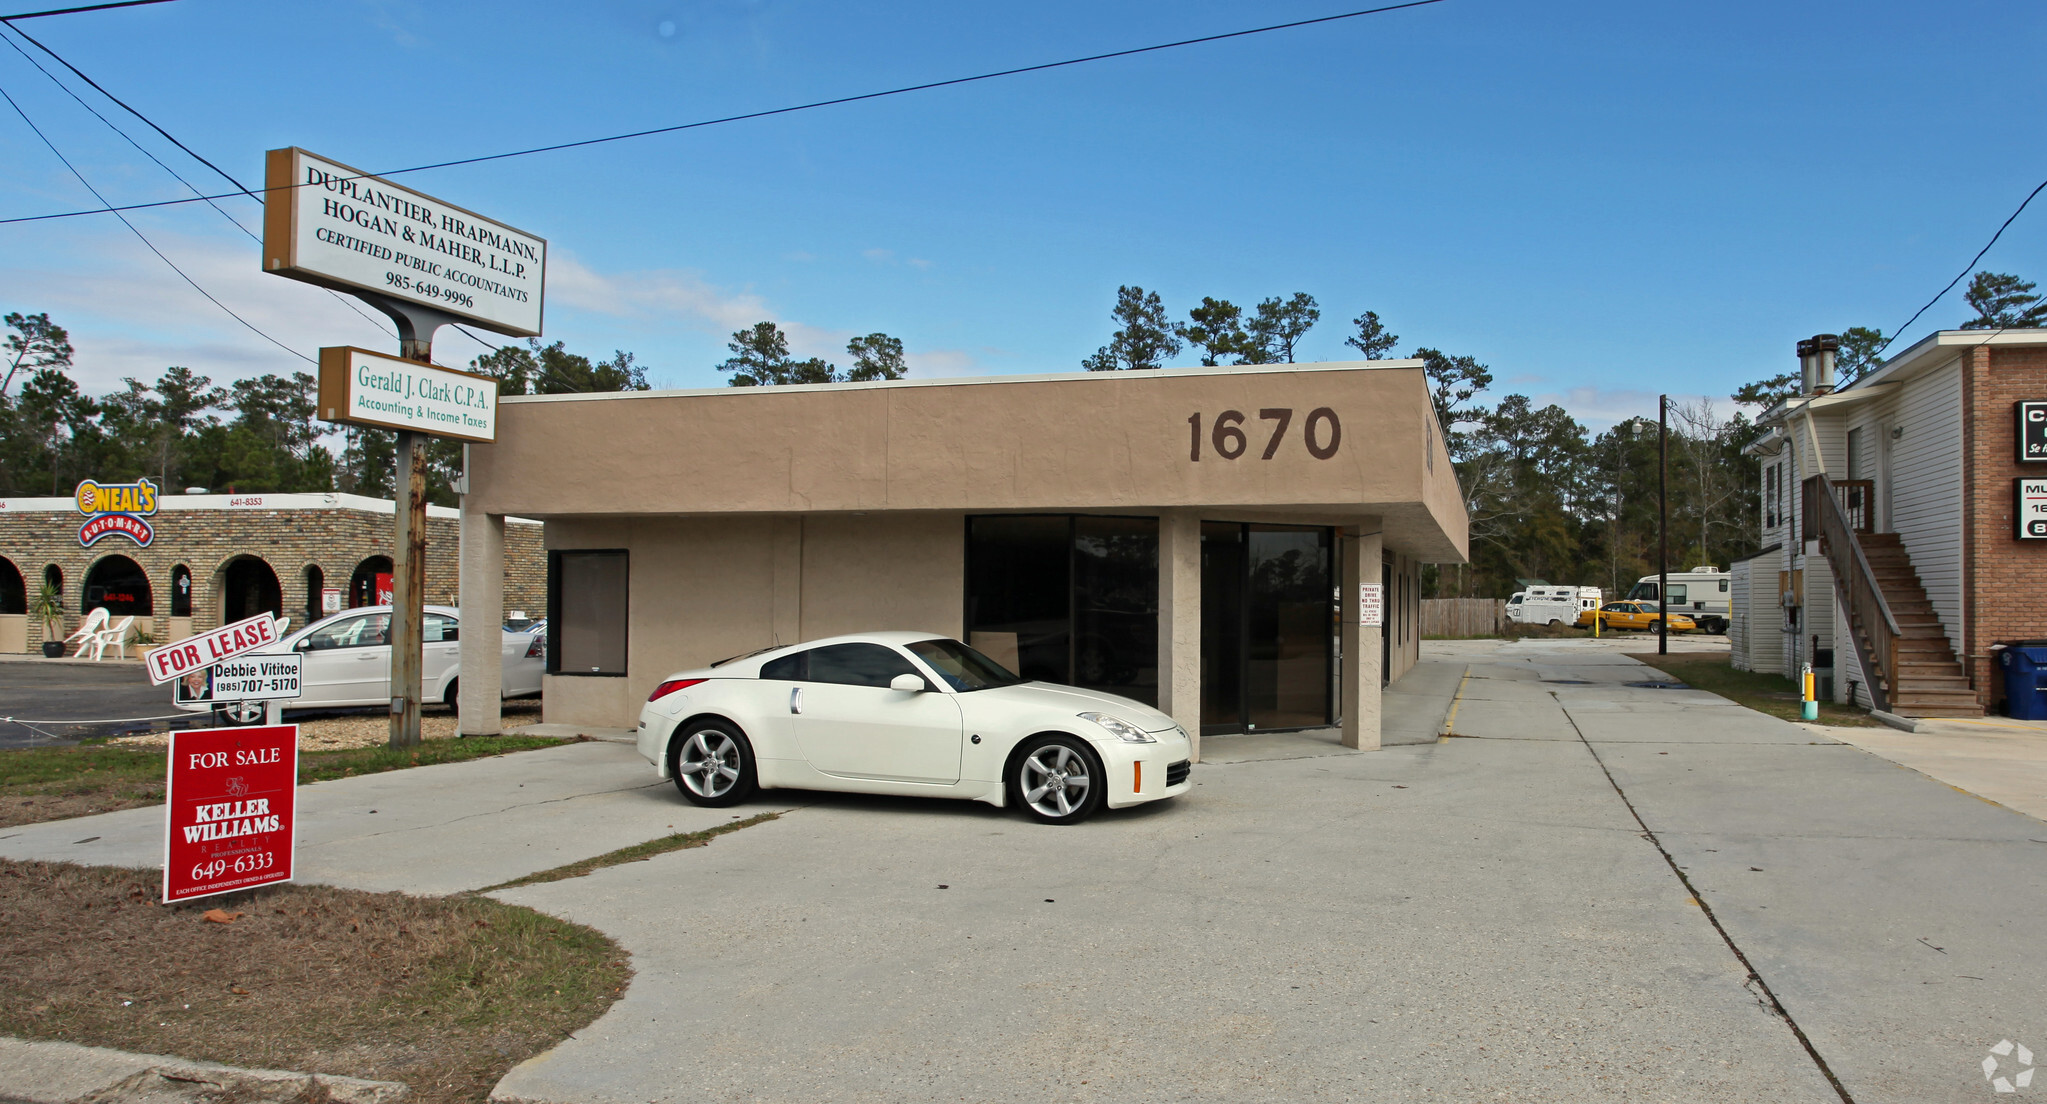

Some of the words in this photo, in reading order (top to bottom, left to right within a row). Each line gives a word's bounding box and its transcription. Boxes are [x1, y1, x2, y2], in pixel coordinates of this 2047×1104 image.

[307, 166, 438, 229] DUPLANTIER,
[441, 214, 538, 264] HRAPMANN,
[323, 197, 398, 238] HOGAN
[402, 225, 416, 244] &
[419, 230, 486, 268] MAHER,
[489, 253, 526, 280] L.L.P.
[316, 227, 392, 260] CERTIFIED
[395, 251, 441, 276] PUBLIC
[443, 268, 529, 303] ACCOUNTANTS
[386, 271, 474, 308] 985-649-9996
[358, 365, 402, 393] Gerald
[405, 375, 415, 400] J.
[419, 377, 451, 403] Clark
[454, 385, 489, 410] C.P.A.
[358, 395, 413, 419] Accounting
[416, 405, 424, 418] &
[427, 407, 460, 424] Income
[463, 413, 488, 429] Taxes
[2028, 409, 2047, 422] C
[1188, 407, 1342, 462] 1670
[230, 497, 263, 507] 641-8353
[157, 644, 202, 676] FOR
[207, 620, 272, 659] LEASE
[215, 664, 257, 678] Debbie
[260, 662, 298, 676] Vititoe
[189, 752, 229, 770] FOR
[236, 747, 281, 766] SALE
[195, 798, 270, 823] KELLER
[191, 851, 274, 881] 649-6333
[211, 846, 262, 858] PROFESSIONALS
[176, 887, 190, 895] EACH
[190, 884, 207, 893] OFFICE
[207, 879, 242, 890] INDEPENDENTLY
[243, 876, 259, 884] OWNED
[263, 871, 284, 880] OPERATED
